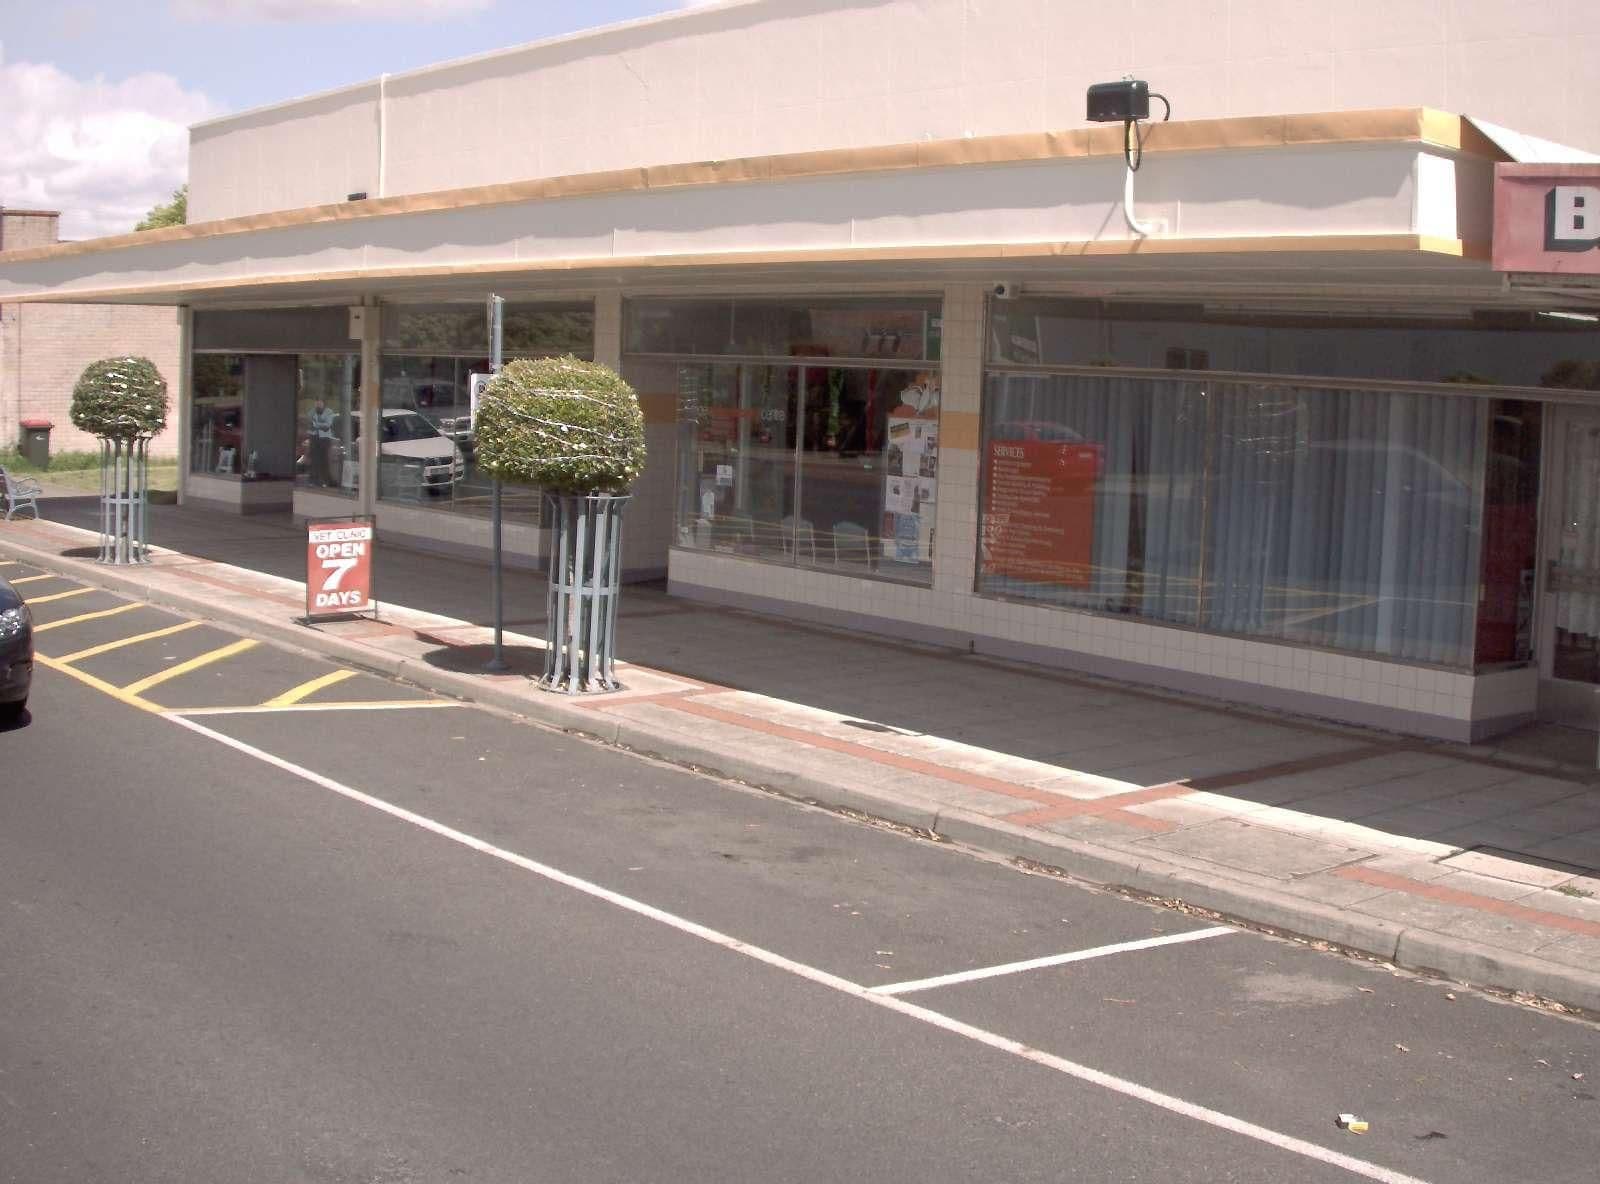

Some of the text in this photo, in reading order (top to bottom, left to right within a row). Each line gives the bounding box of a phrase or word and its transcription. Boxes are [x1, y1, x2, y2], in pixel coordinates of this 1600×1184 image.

[316, 543, 365, 558] OPEN
[322, 558, 359, 591] 7
[316, 591, 361, 606] DAYS
